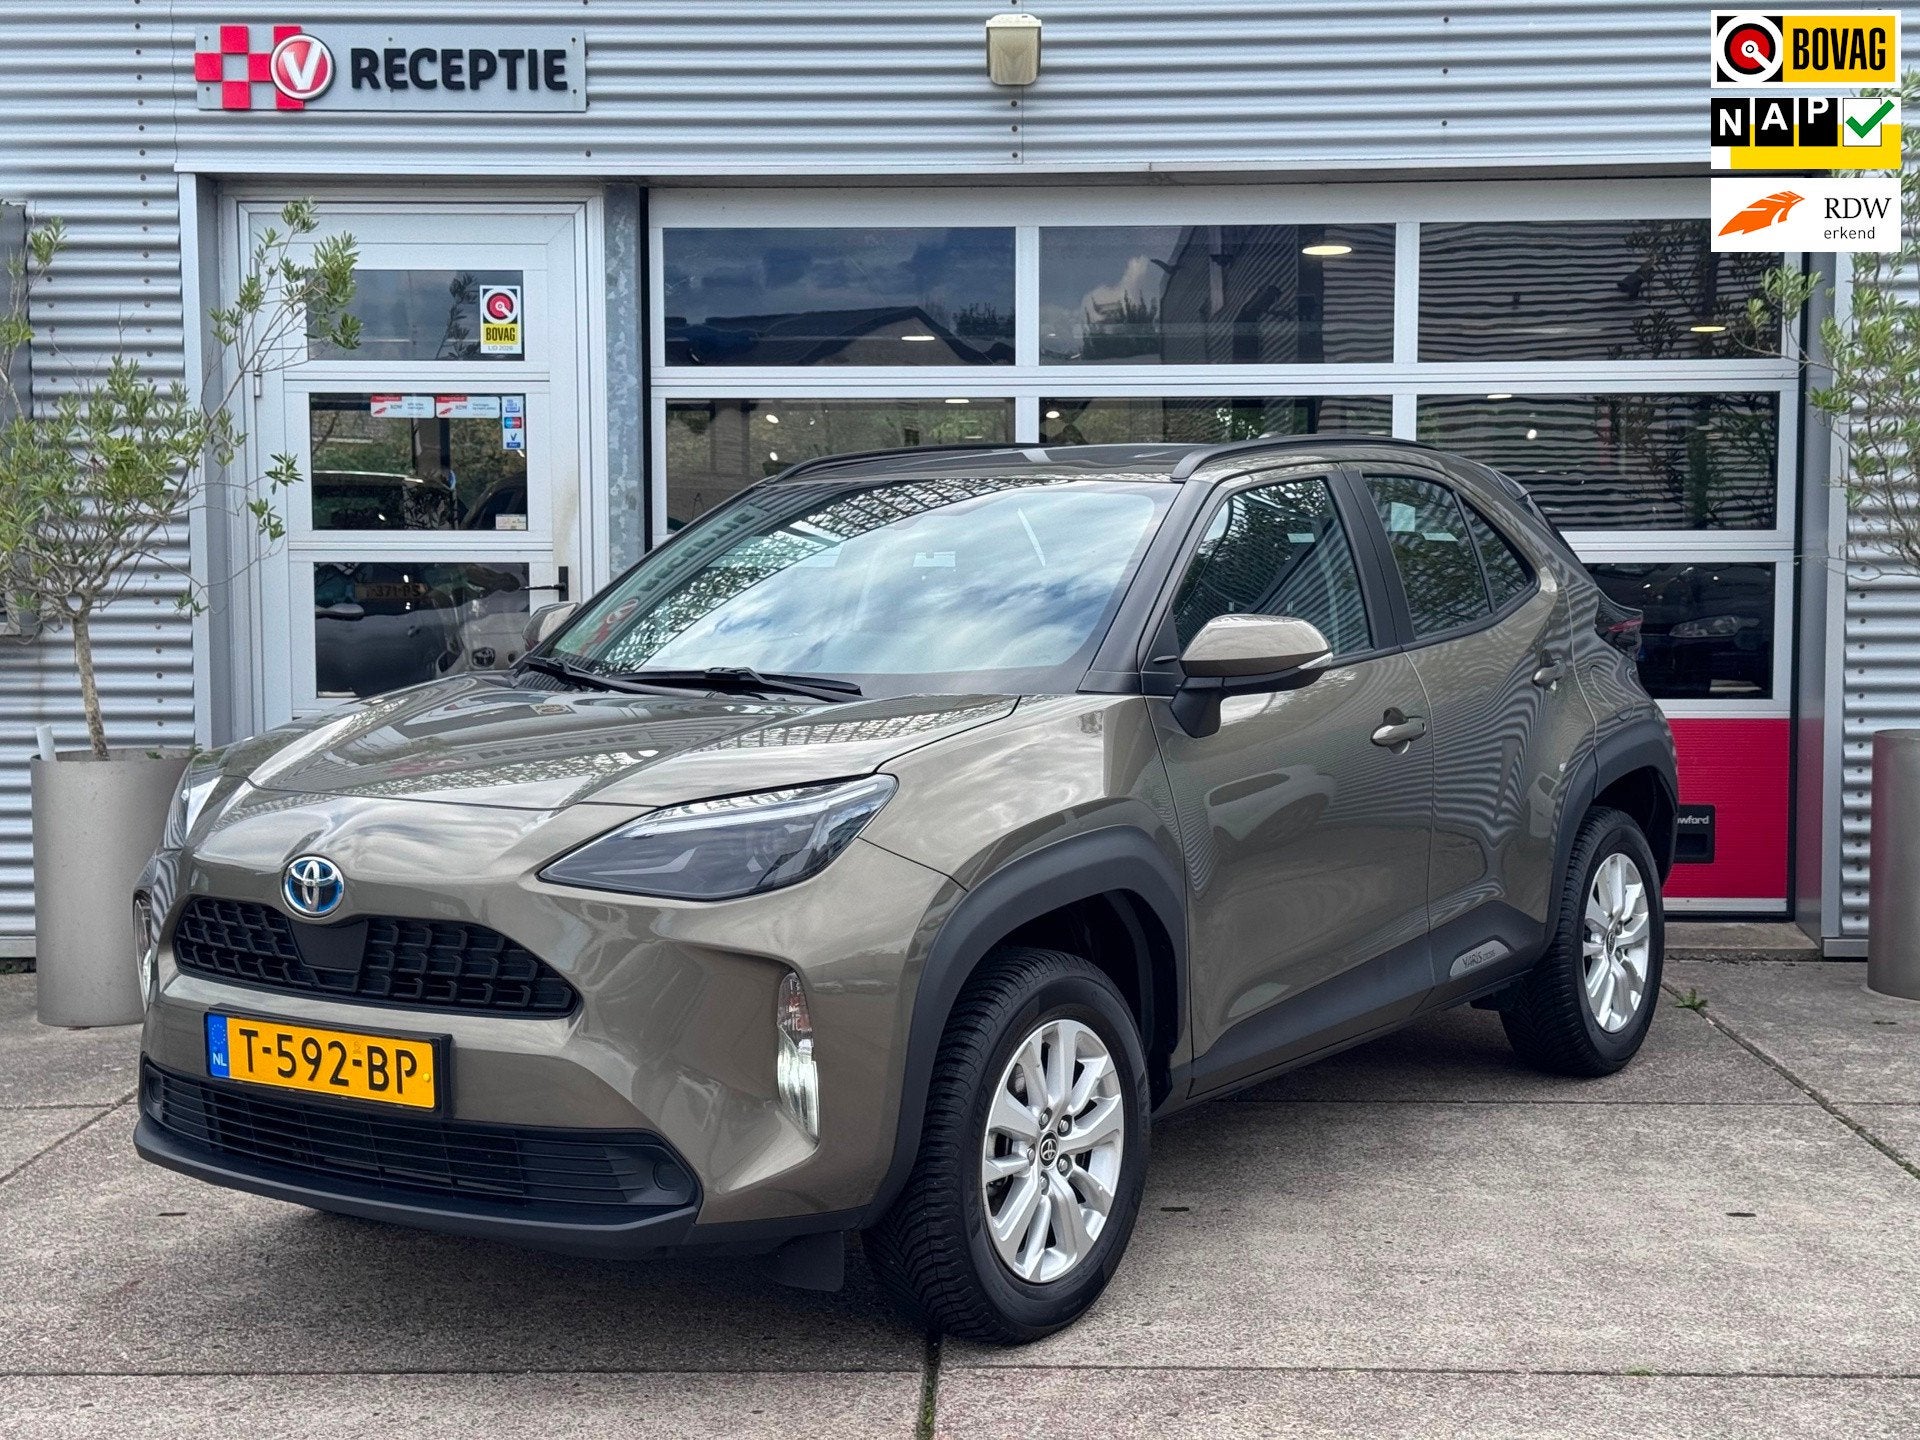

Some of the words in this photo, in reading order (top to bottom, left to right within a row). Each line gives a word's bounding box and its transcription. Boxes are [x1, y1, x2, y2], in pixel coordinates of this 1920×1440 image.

[351, 48, 568, 91] RECEPTIE
[485, 327, 516, 342] BOVAG
[212, 1052, 227, 1067] NL
[239, 1028, 418, 1094] T-592-BP
